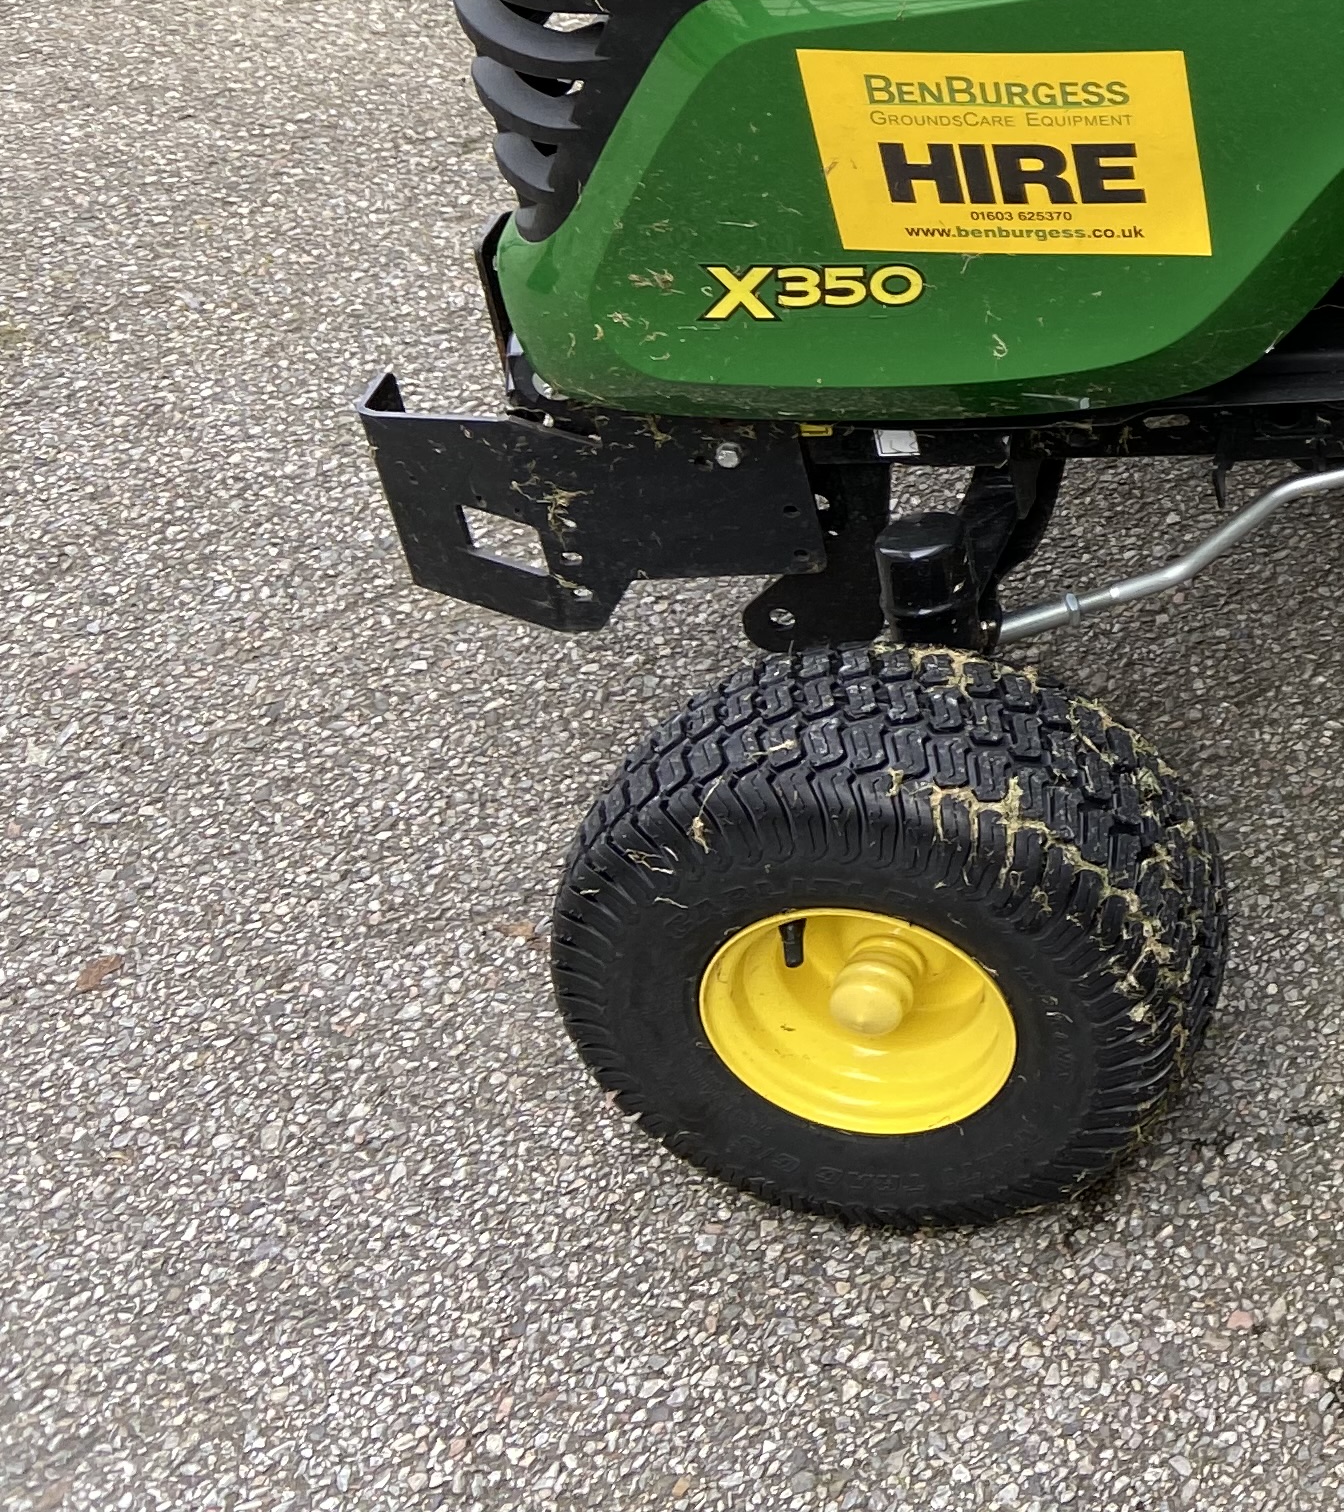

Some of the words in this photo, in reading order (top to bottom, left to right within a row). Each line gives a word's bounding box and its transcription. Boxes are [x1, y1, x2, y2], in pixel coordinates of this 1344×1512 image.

[1025, 112, 1133, 128] EQUIPMENT
[878, 141, 1148, 205] HIRE
[969, 211, 1014, 222] 01603
[1017, 211, 1073, 222] 625370
[904, 225, 1146, 242] www.benburgess.co.uk
[695, 263, 927, 322] X350
